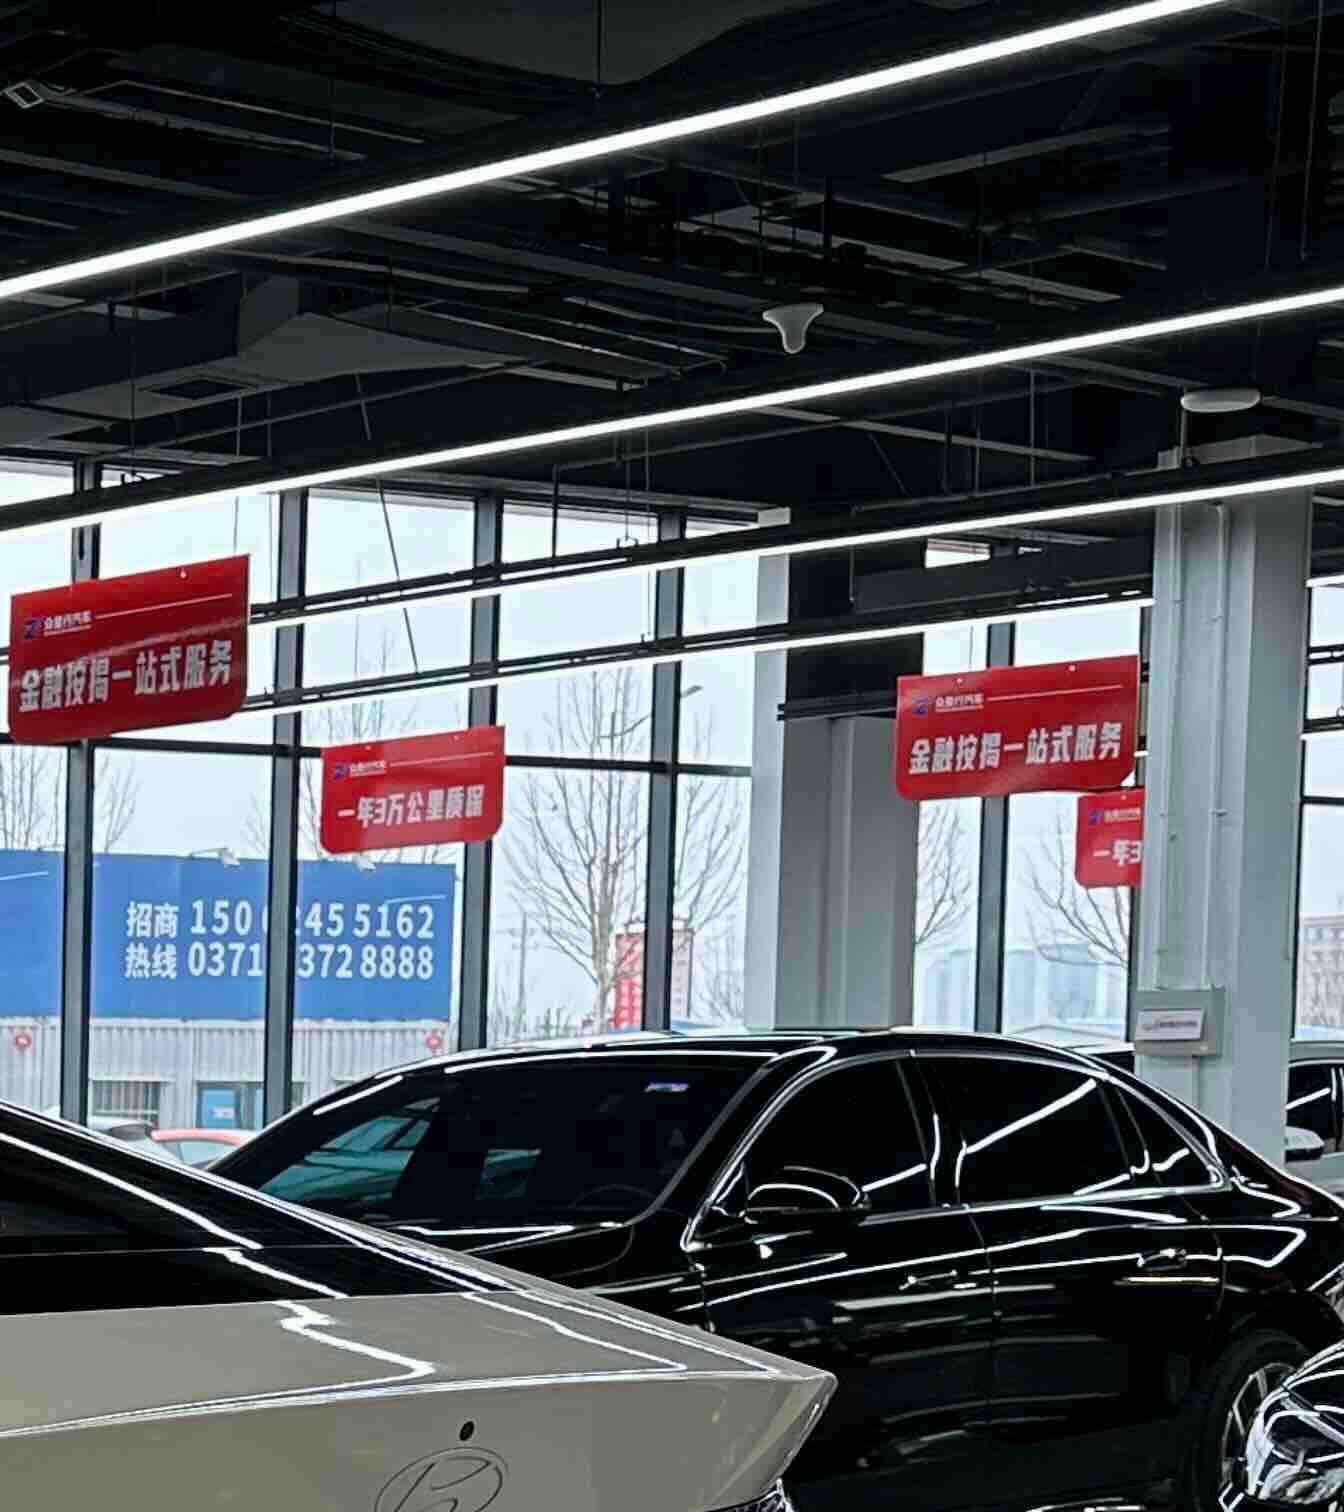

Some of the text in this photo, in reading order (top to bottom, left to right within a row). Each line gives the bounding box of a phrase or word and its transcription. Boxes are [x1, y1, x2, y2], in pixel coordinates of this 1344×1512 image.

[19, 640, 232, 712] 金融按揭一站式服务
[909, 721, 1122, 774] 金融按揭一站式服务
[337, 784, 485, 829] 一年3万公里质保
[126, 901, 179, 939] 招商
[124, 942, 177, 980] 热线
